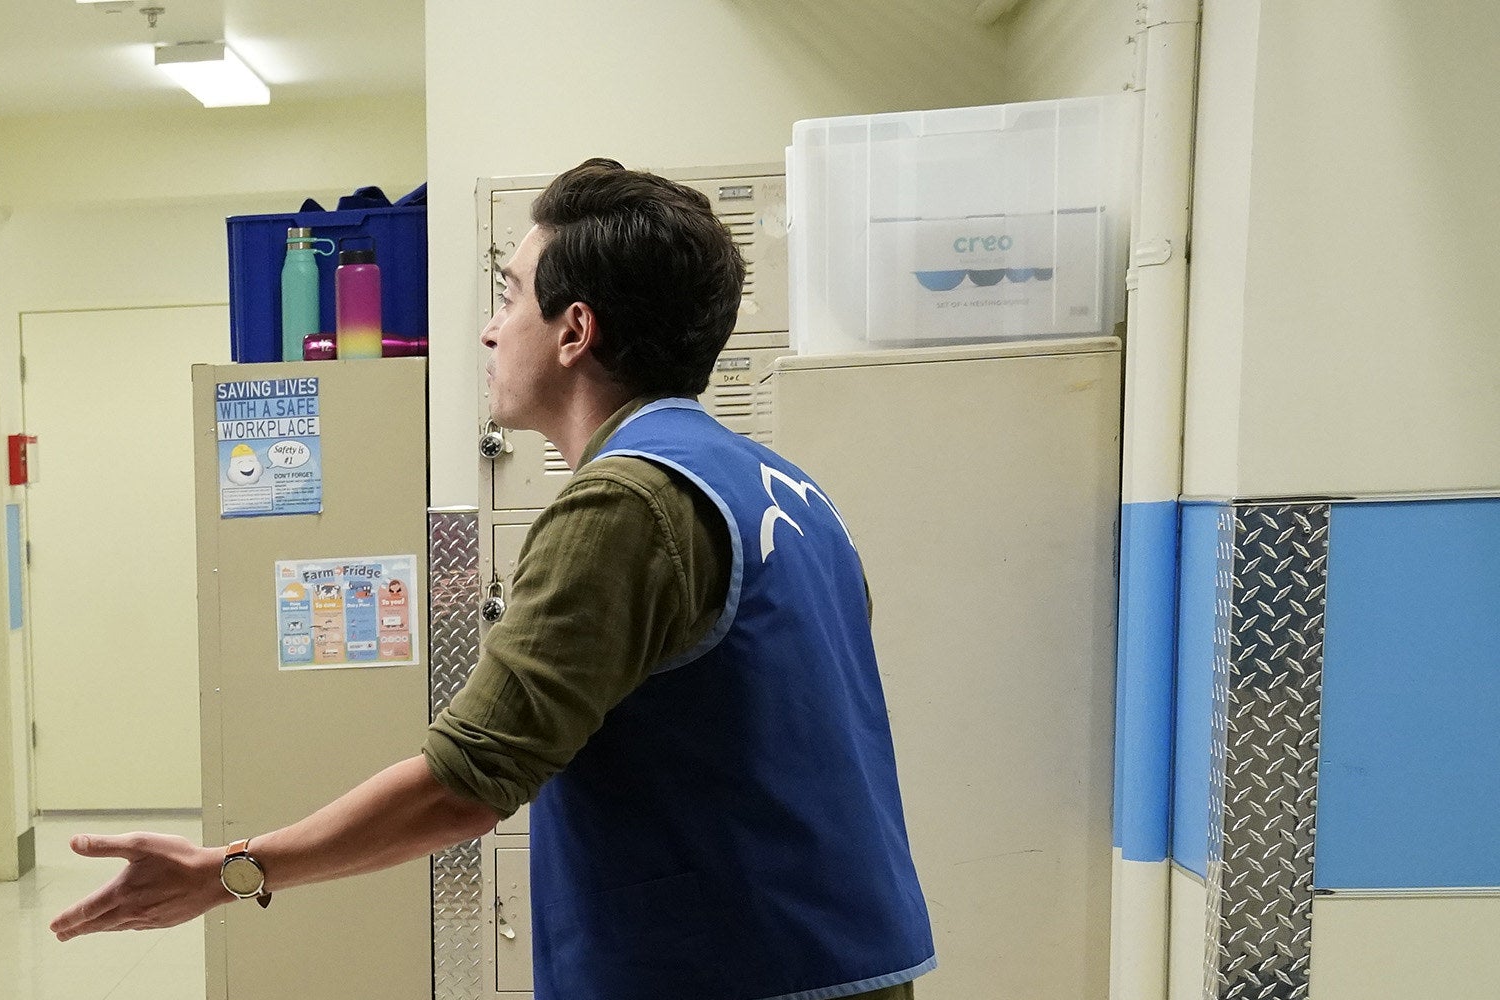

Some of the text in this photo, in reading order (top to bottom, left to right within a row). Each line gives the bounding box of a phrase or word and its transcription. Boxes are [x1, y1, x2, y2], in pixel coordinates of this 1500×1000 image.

[953, 234, 1014, 254] creo
[217, 378, 317, 399] SAVING LIVES
[220, 397, 316, 419] WITH A SAFE
[222, 418, 316, 439] WORKPLACE
[273, 444, 305, 455] Safety is
[284, 456, 293, 465] #1
[302, 565, 381, 582] Farm Fridge
